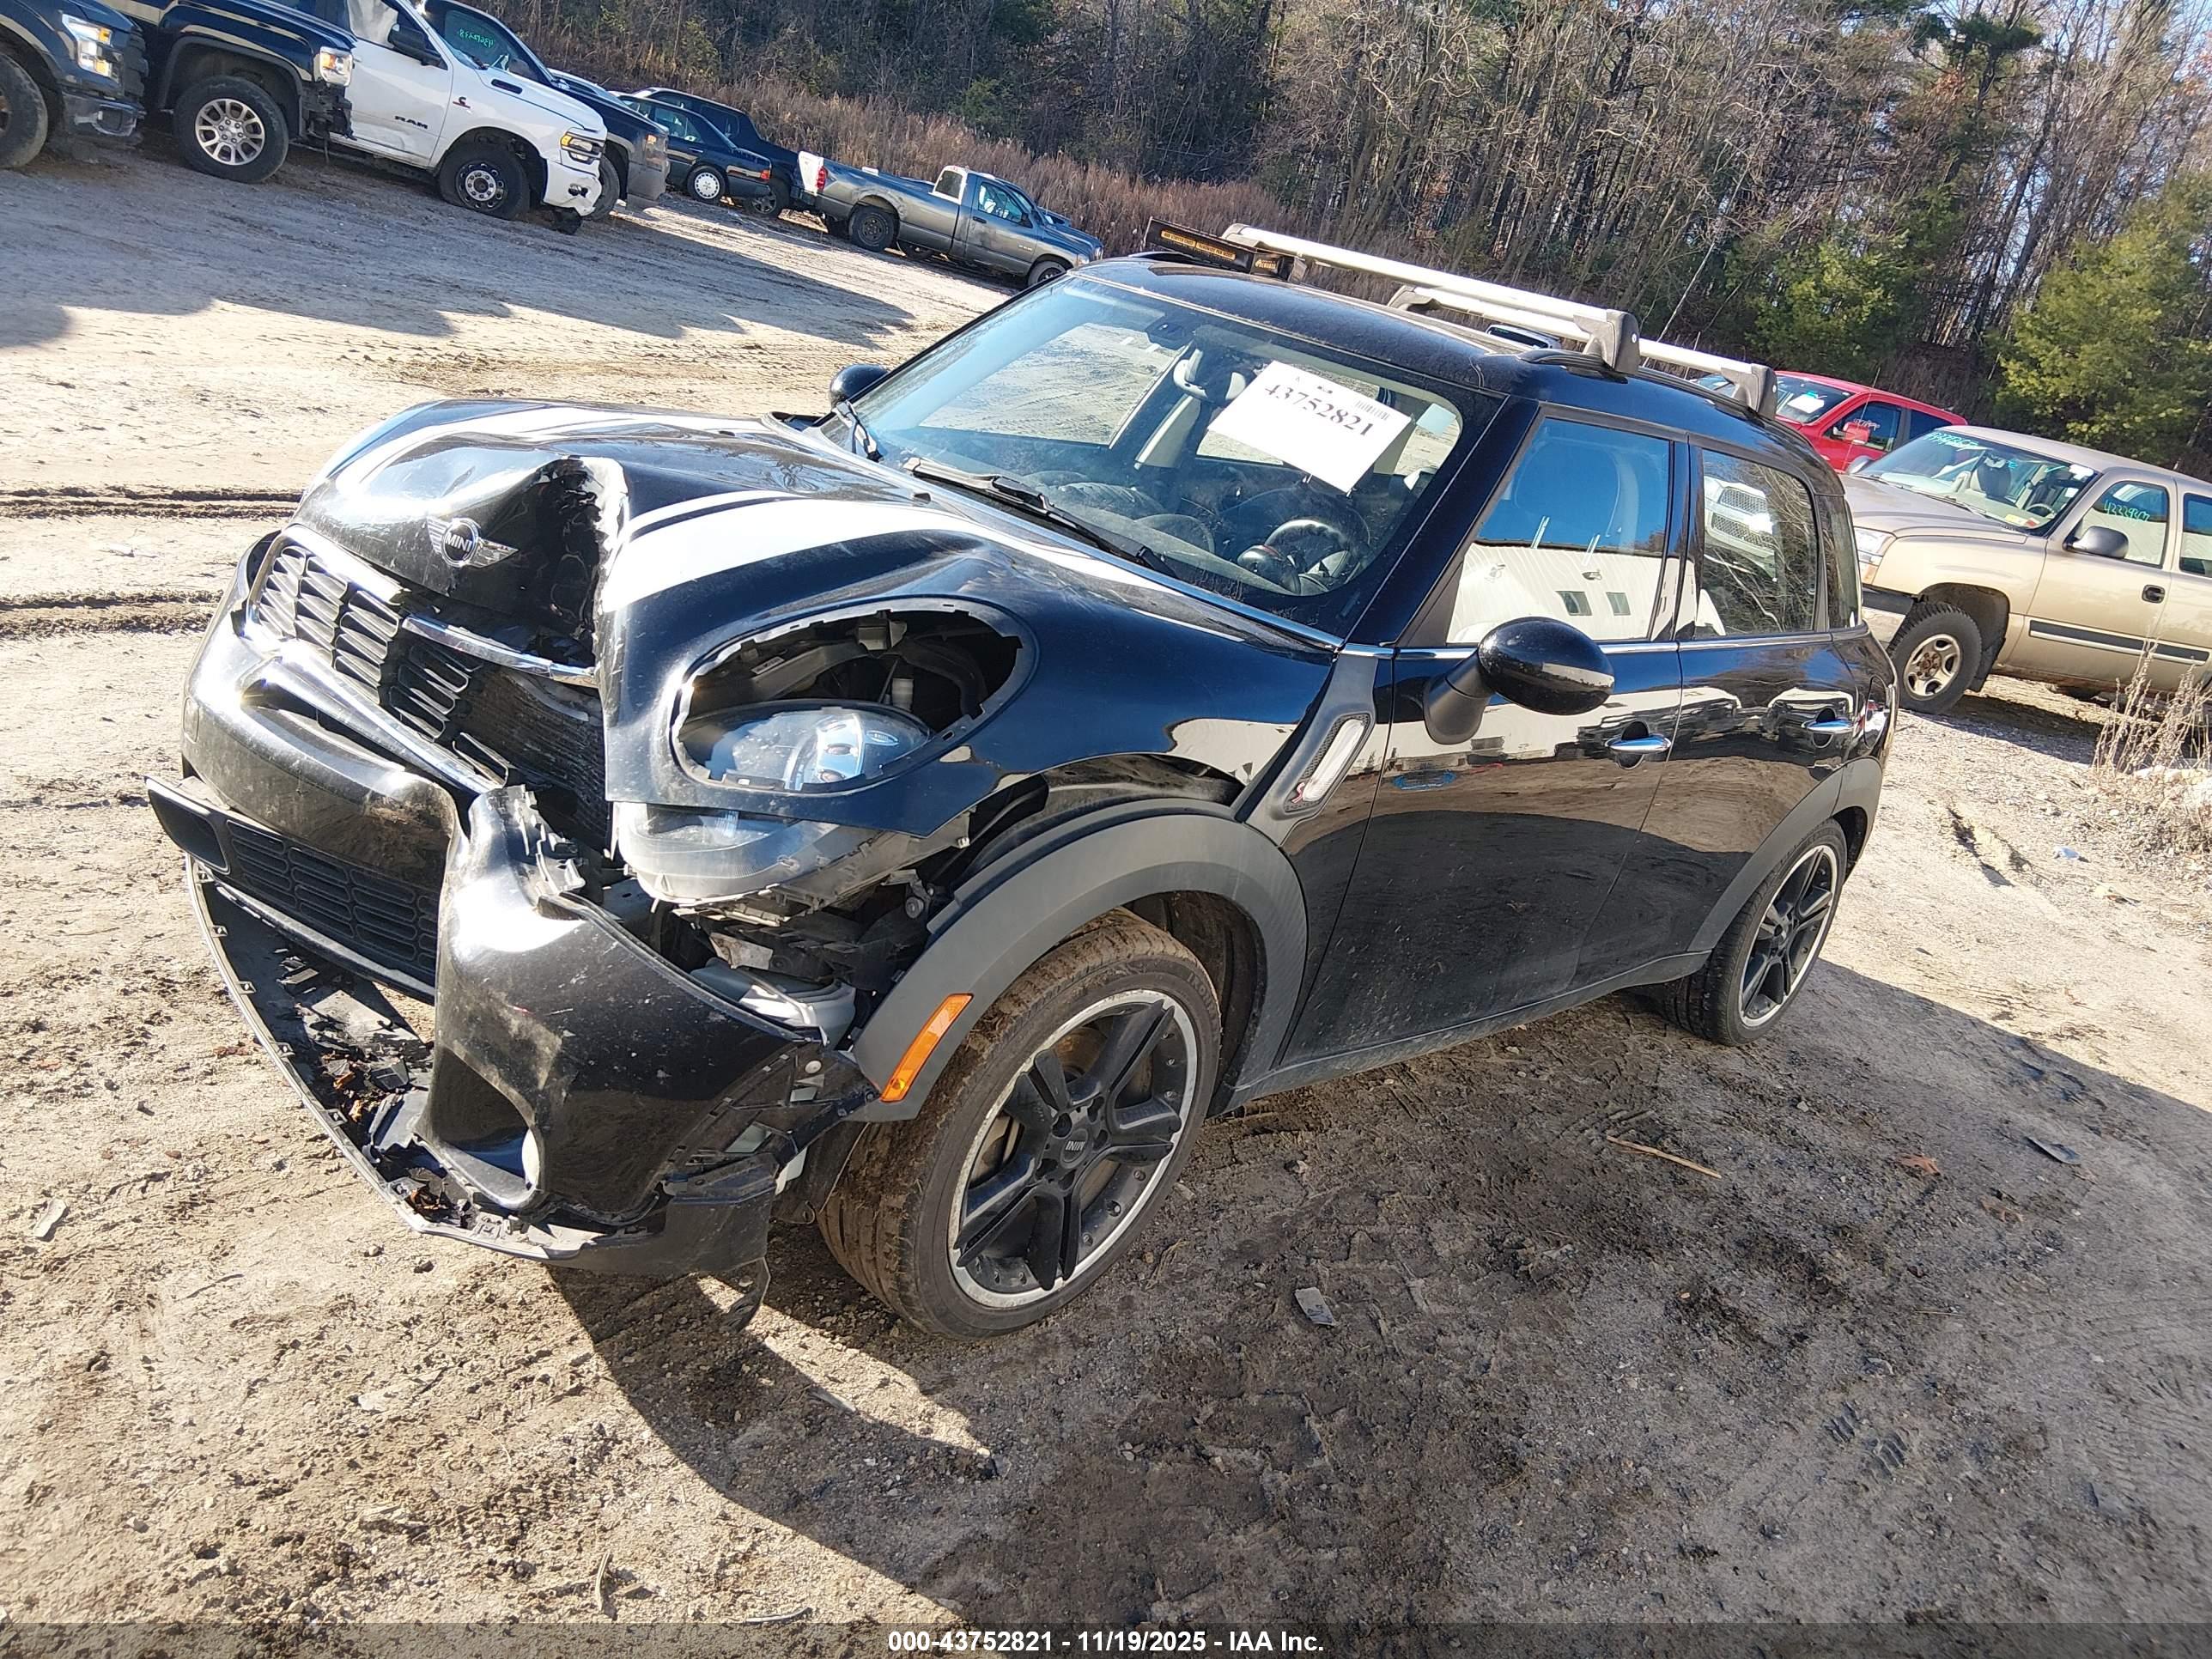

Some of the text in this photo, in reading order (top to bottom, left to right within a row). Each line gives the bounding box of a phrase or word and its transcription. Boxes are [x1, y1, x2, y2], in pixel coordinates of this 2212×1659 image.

[395, 116, 428, 129] RAM
[1265, 384, 1374, 436] 43752821
[446, 532, 472, 553] MINI
[1065, 1140, 1085, 1152] MINI
